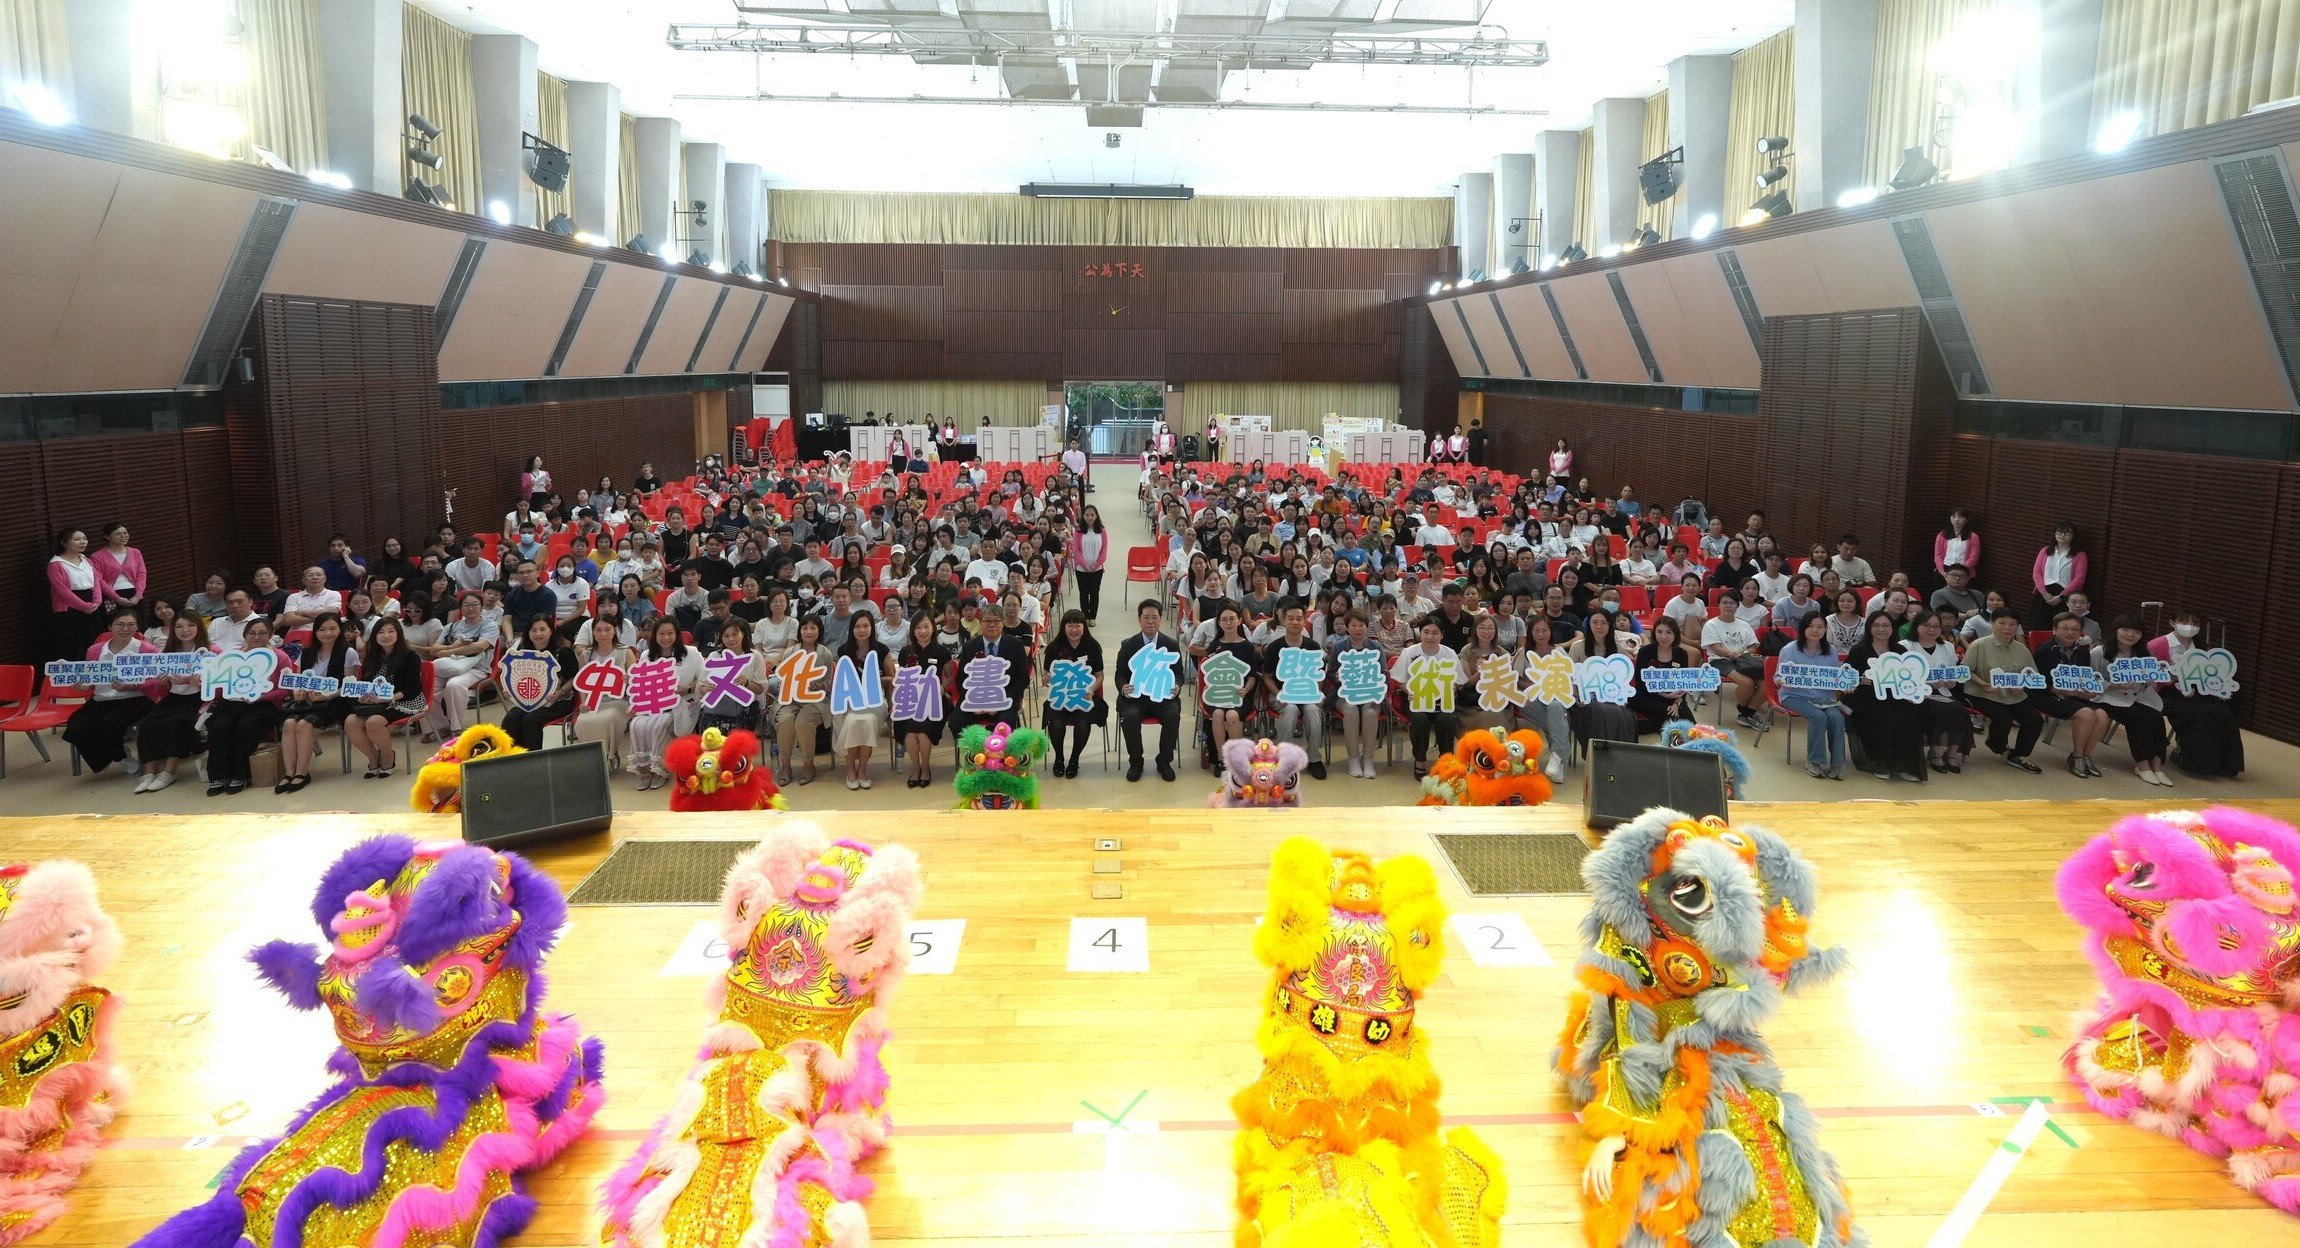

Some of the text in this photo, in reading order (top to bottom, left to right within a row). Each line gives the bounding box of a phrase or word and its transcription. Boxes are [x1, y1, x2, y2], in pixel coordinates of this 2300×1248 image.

[116, 654, 204, 665] 匯聚星光閃耀人
[121, 666, 157, 677] 保良局
[1129, 645, 1177, 700] 佈
[1781, 665, 1857, 679] 匯聚星光閃耀人生
[2059, 666, 2092, 679] 保良局
[2117, 659, 2157, 671] 保良局
[53, 674, 90, 685] 保良局
[206, 664, 257, 697] 148
[281, 674, 336, 692] 匯聚星光
[579, 661, 624, 710] 中
[630, 660, 680, 714] 華
[705, 652, 753, 706] 文
[779, 652, 825, 702] 化
[833, 653, 882, 712] AI
[962, 658, 1012, 709] 畫
[1049, 660, 1096, 711] 發
[1204, 654, 1250, 706] 會
[1278, 650, 1324, 702] 暨
[1338, 650, 1385, 703] 藝
[1410, 659, 1455, 711] 術
[1479, 655, 1525, 711] 表
[1527, 650, 1575, 706] 演
[1643, 669, 1719, 680] 匯聚星光閃耀人生
[1648, 680, 1715, 690] 保良局 ShineOn
[1785, 676, 1852, 689] 保良局 ShineOn
[1874, 668, 1918, 697] 148
[1993, 674, 2045, 688] 閃耀人生
[2055, 678, 2102, 691] ShineOn
[2112, 671, 2168, 682] ShineOn
[2180, 664, 2225, 692] 148
[342, 681, 392, 698] 閃耀人生
[894, 667, 942, 718] 動
[910, 932, 933, 957] 5
[1091, 928, 1122, 953] 4
[1479, 925, 1517, 950] 2
